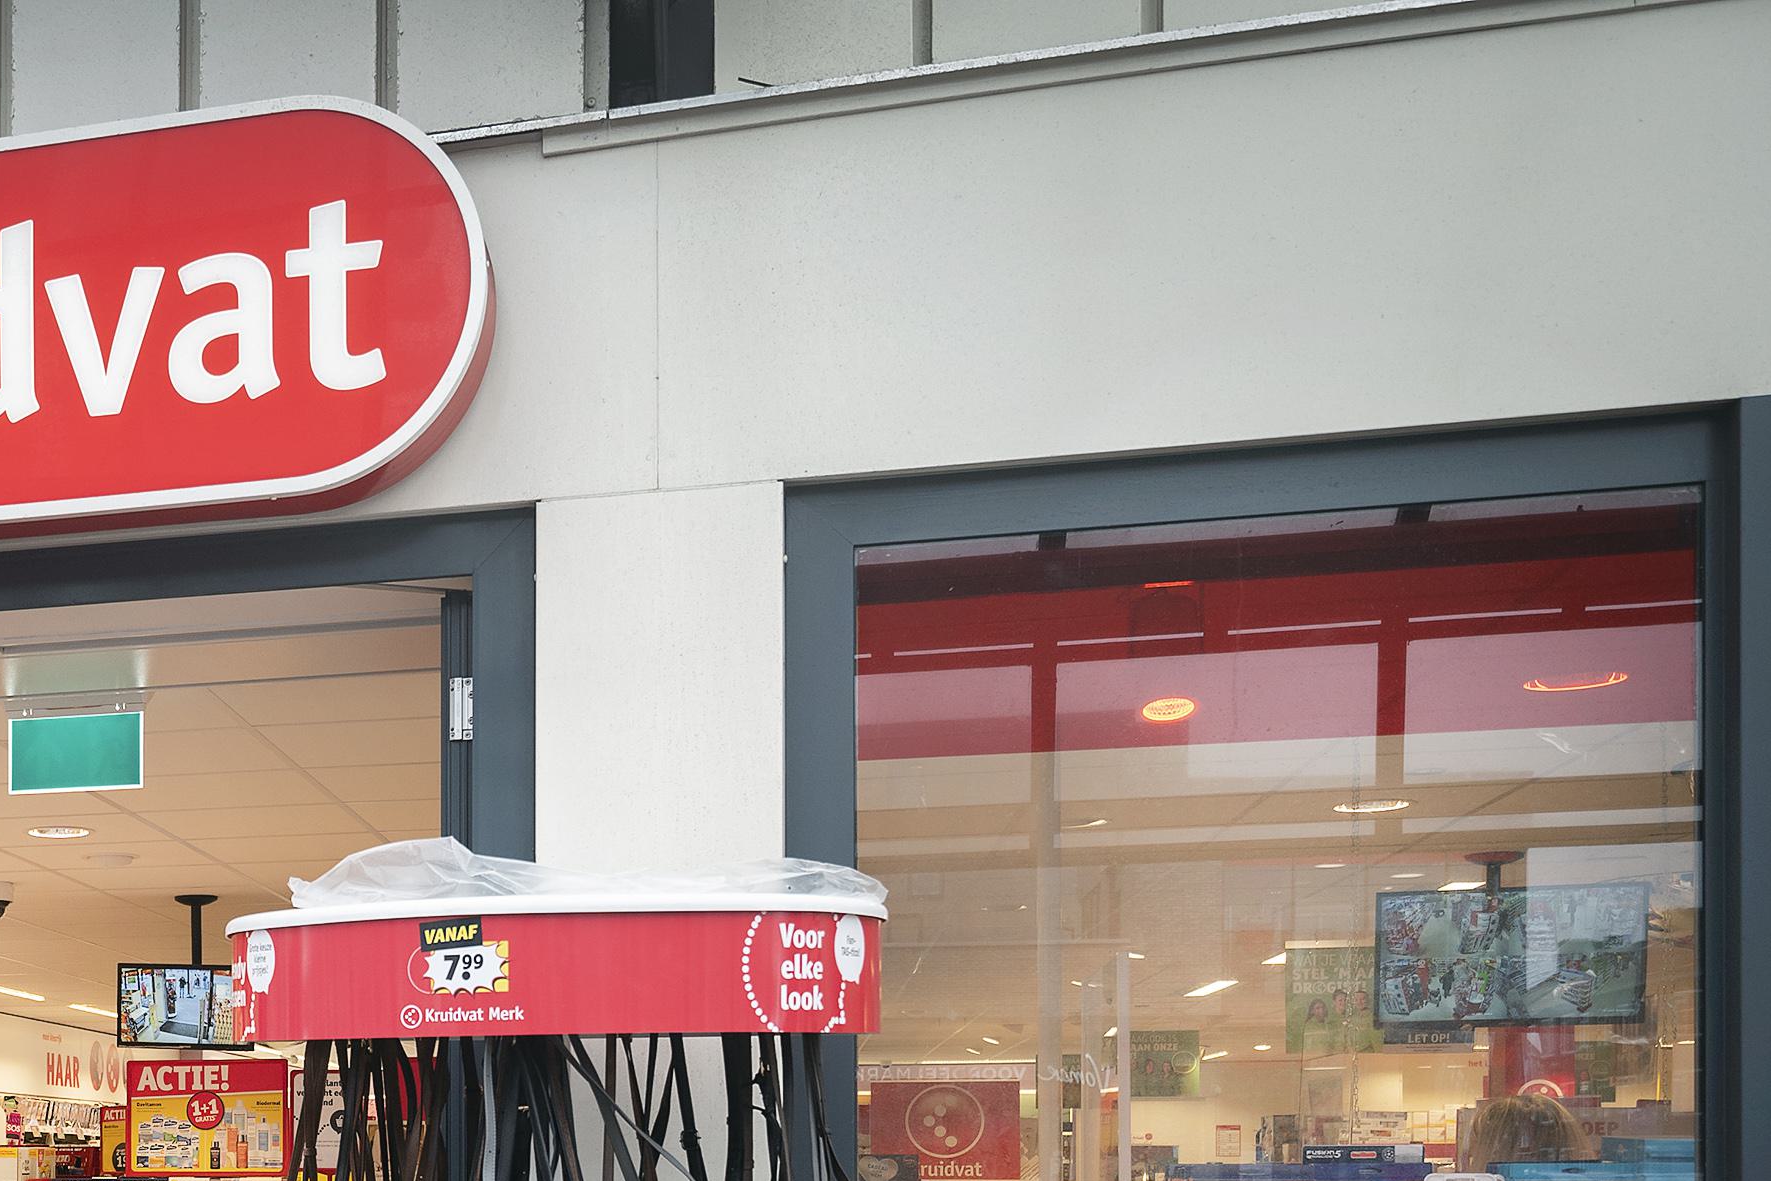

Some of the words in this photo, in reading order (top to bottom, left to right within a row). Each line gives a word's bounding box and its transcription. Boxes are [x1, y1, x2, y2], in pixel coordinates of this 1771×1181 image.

[424, 923, 478, 945] VANAF
[779, 922, 825, 949] Voor
[443, 953, 484, 981] 7.99
[780, 954, 823, 980] elke
[780, 984, 824, 1010] look
[425, 1006, 484, 1023] Kruidvat
[489, 1004, 525, 1021] Merk
[1407, 1033, 1428, 1043] LET
[1431, 1033, 1450, 1043] OP!
[46, 1052, 80, 1088] HAAR
[136, 1065, 230, 1092] ACTIE!
[191, 1099, 220, 1117] 1+1
[195, 1115, 216, 1123] GRATIS
[6, 1124, 21, 1132] SOS
